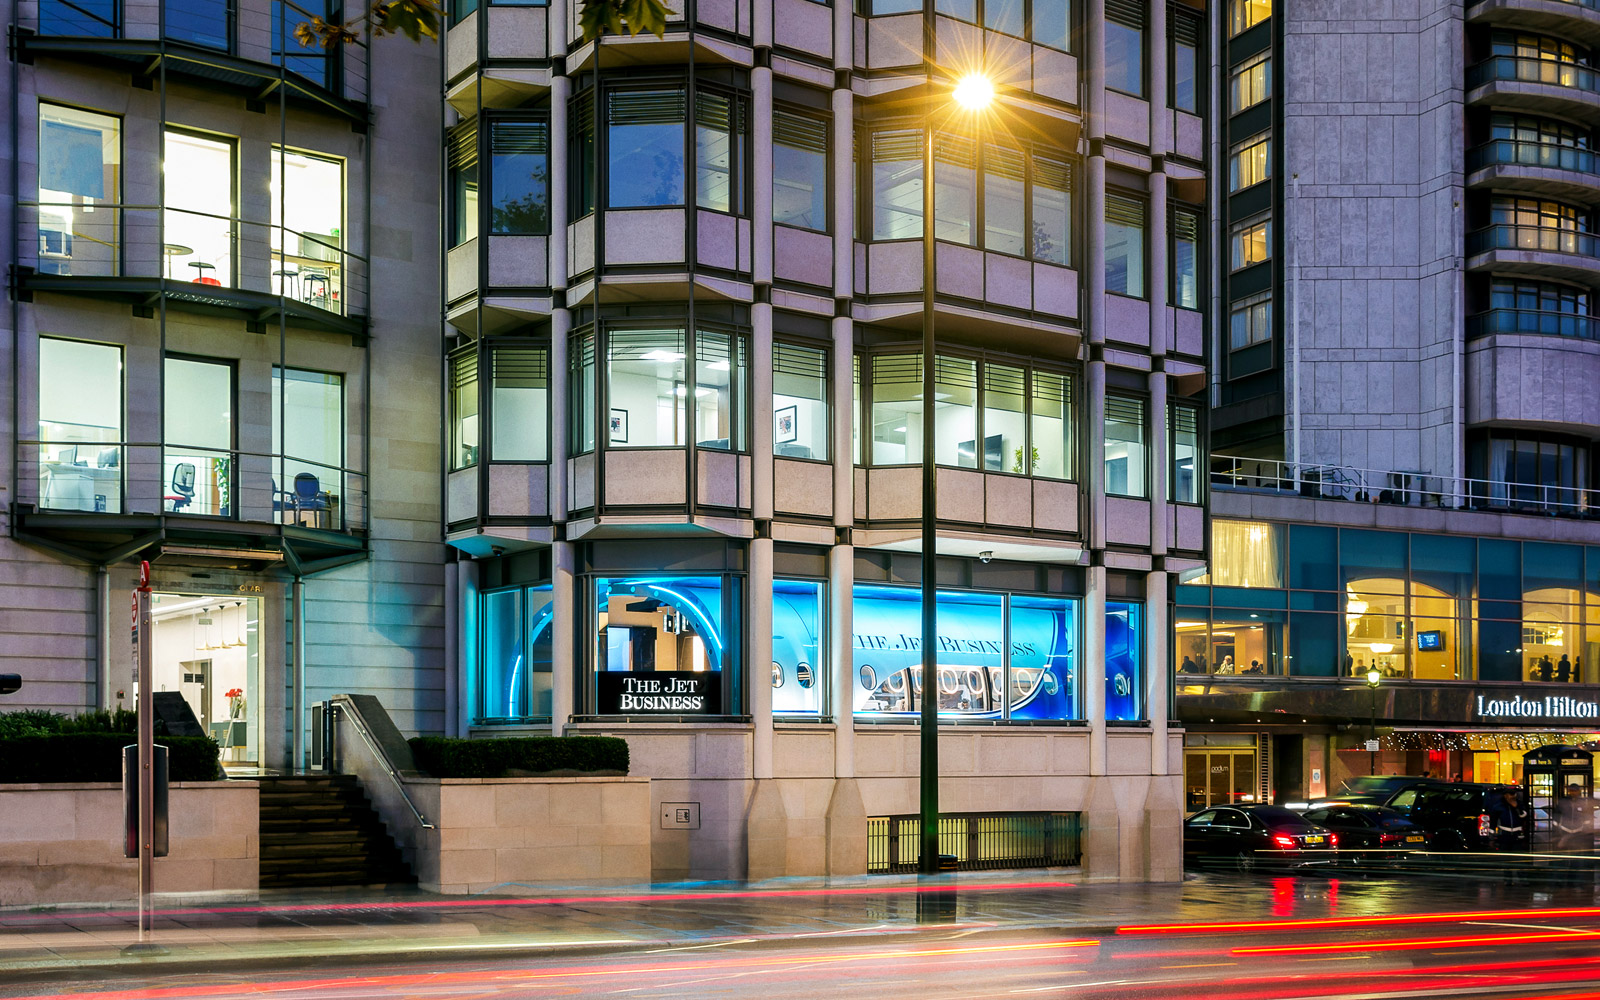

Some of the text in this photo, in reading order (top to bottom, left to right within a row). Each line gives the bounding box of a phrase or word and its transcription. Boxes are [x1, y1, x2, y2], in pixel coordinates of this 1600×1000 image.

[140, 563, 146, 582] A
[853, 634, 1036, 657] HE JE BUSINSS
[623, 677, 698, 693] THE JET
[620, 693, 702, 709] BUSINESS
[1477, 695, 1598, 717] London Hilton
